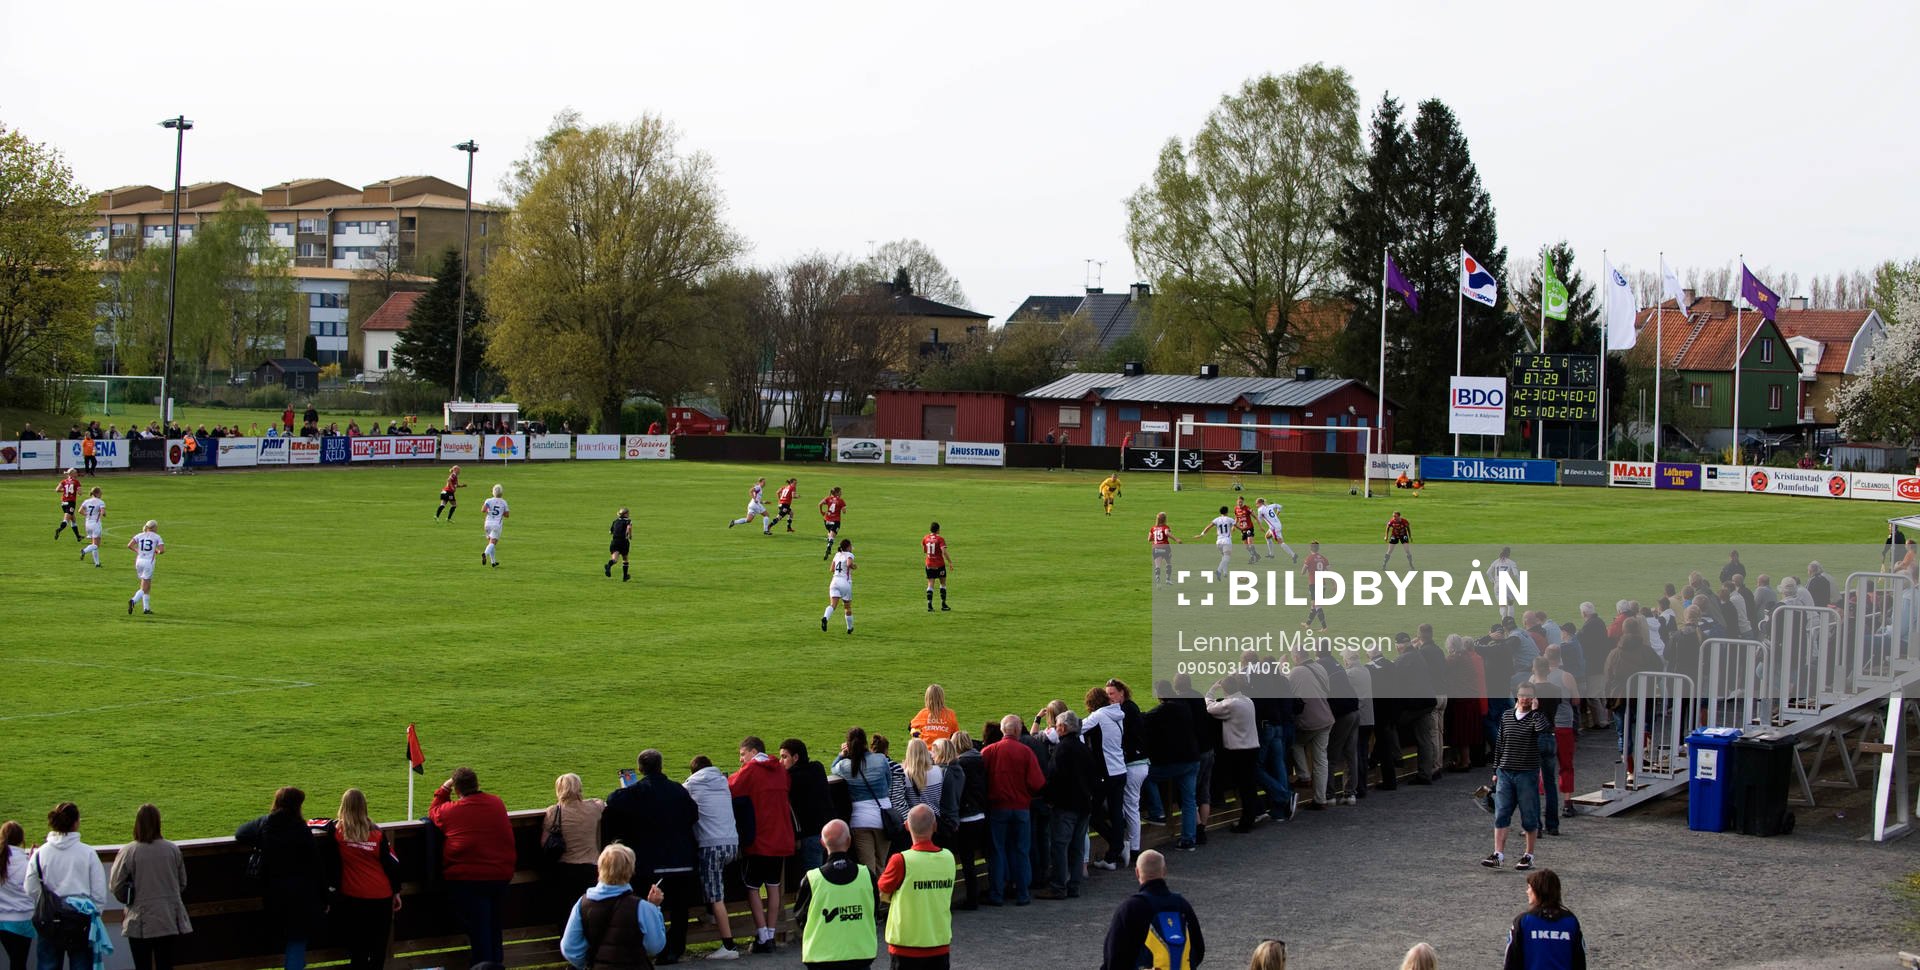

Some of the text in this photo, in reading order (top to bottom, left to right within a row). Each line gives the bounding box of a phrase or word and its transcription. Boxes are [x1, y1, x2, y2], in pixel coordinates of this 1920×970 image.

[1515, 357, 1522, 366] H
[1532, 356, 1551, 368] 2-6
[1524, 372, 1559, 385] 87:29
[1458, 388, 1504, 406] BDO
[94, 441, 117, 457] ENA
[260, 439, 285, 456] pmr
[327, 438, 345, 449] BLUE
[532, 440, 568, 449] sandelins
[325, 450, 346, 461] KELD
[950, 445, 1000, 457] ÅHUSSTRAND
[1452, 460, 1525, 480] Folksam
[1614, 464, 1652, 477] MAXI
[1664, 467, 1693, 478] Löfbergs
[1672, 476, 1685, 486] Lila
[1774, 471, 1823, 483] Kristianstads
[64, 484, 74, 497] 14
[1777, 482, 1819, 493] Damfotboll
[88, 505, 95, 516] 7
[491, 505, 500, 516] 5
[829, 503, 836, 513] 4
[1268, 509, 1275, 518] 6
[1219, 524, 1228, 534] 11
[1153, 530, 1164, 541] 15
[140, 539, 153, 551] 13
[926, 542, 936, 555] 11
[835, 561, 843, 573] 4
[839, 905, 862, 914] INTER
[839, 913, 863, 921] SPORT
[1531, 930, 1571, 940] IKEA
